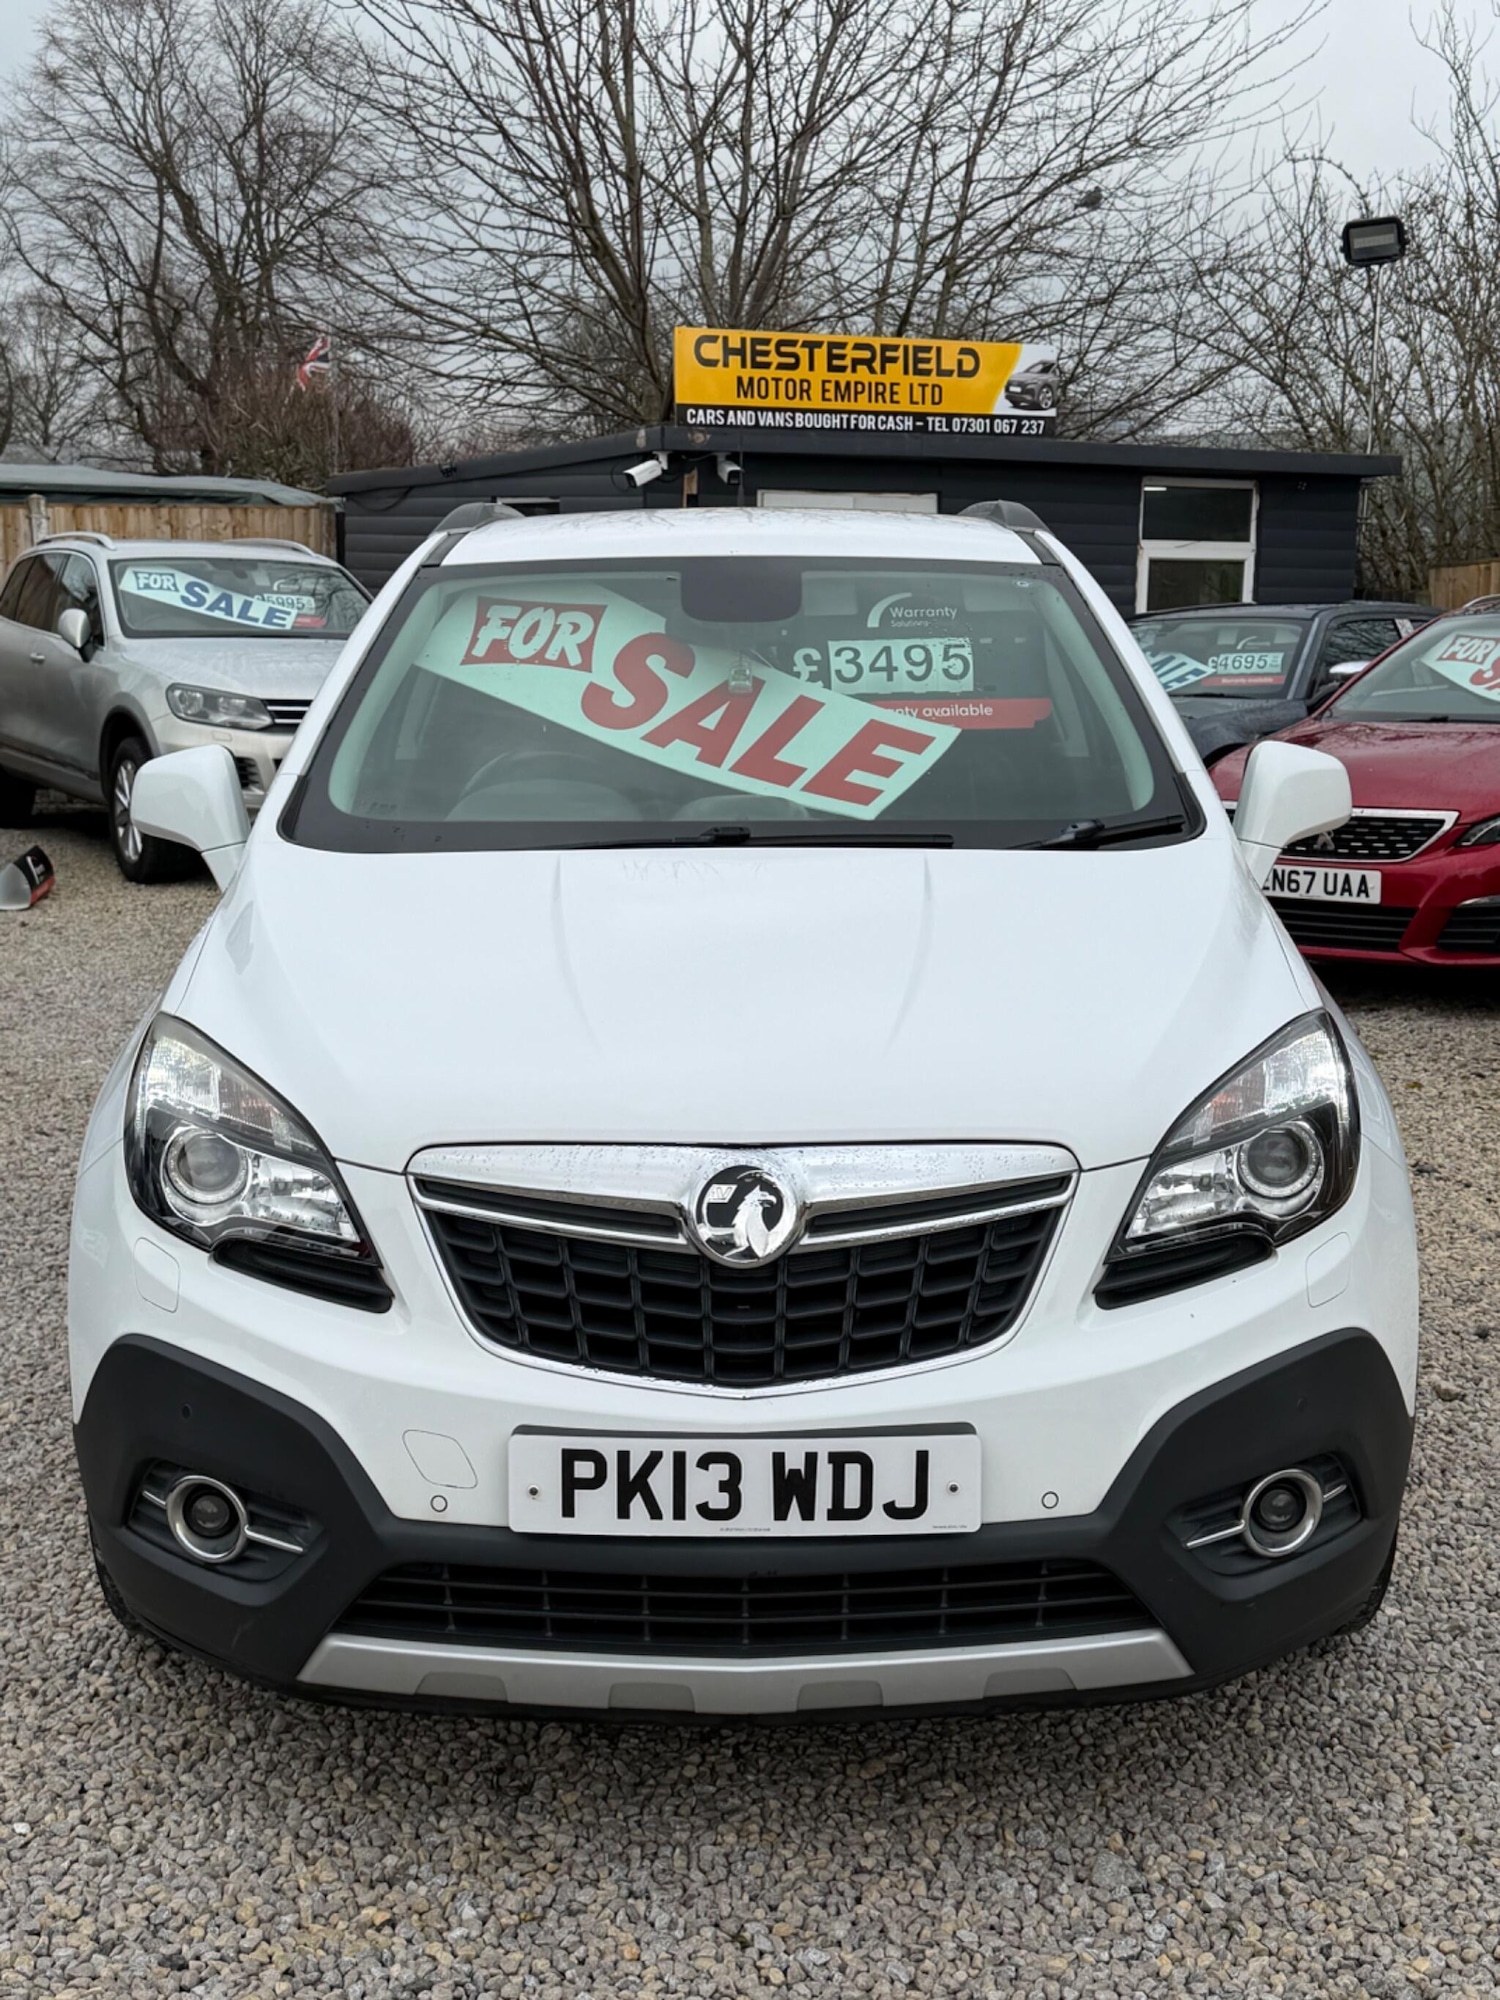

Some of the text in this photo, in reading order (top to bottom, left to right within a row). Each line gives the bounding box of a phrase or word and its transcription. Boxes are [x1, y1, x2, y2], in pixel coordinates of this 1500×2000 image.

[693, 334, 980, 378] CHESTERFIELD
[736, 376, 943, 406] MOTOR EMPIRE LTD
[687, 408, 725, 425] CARS
[727, 410, 756, 426] AND
[757, 411, 794, 428] VANS
[795, 412, 848, 429] BOUGHT
[851, 413, 876, 430] FOR
[878, 414, 913, 431] CASH
[927, 416, 949, 432] TEL
[952, 417, 990, 433] 07301
[993, 418, 1017, 434] 067
[1021, 419, 1045, 434] 237
[137, 573, 292, 628] FOR SALE
[889, 606, 957, 620] Warranty
[793, 643, 970, 687] £3495
[1442, 637, 1496, 663] FOR
[471, 604, 936, 806] FOR SALE
[922, 703, 993, 717] available
[1324, 871, 1370, 898] UAA
[561, 1448, 929, 1521] PK13 WDJ
